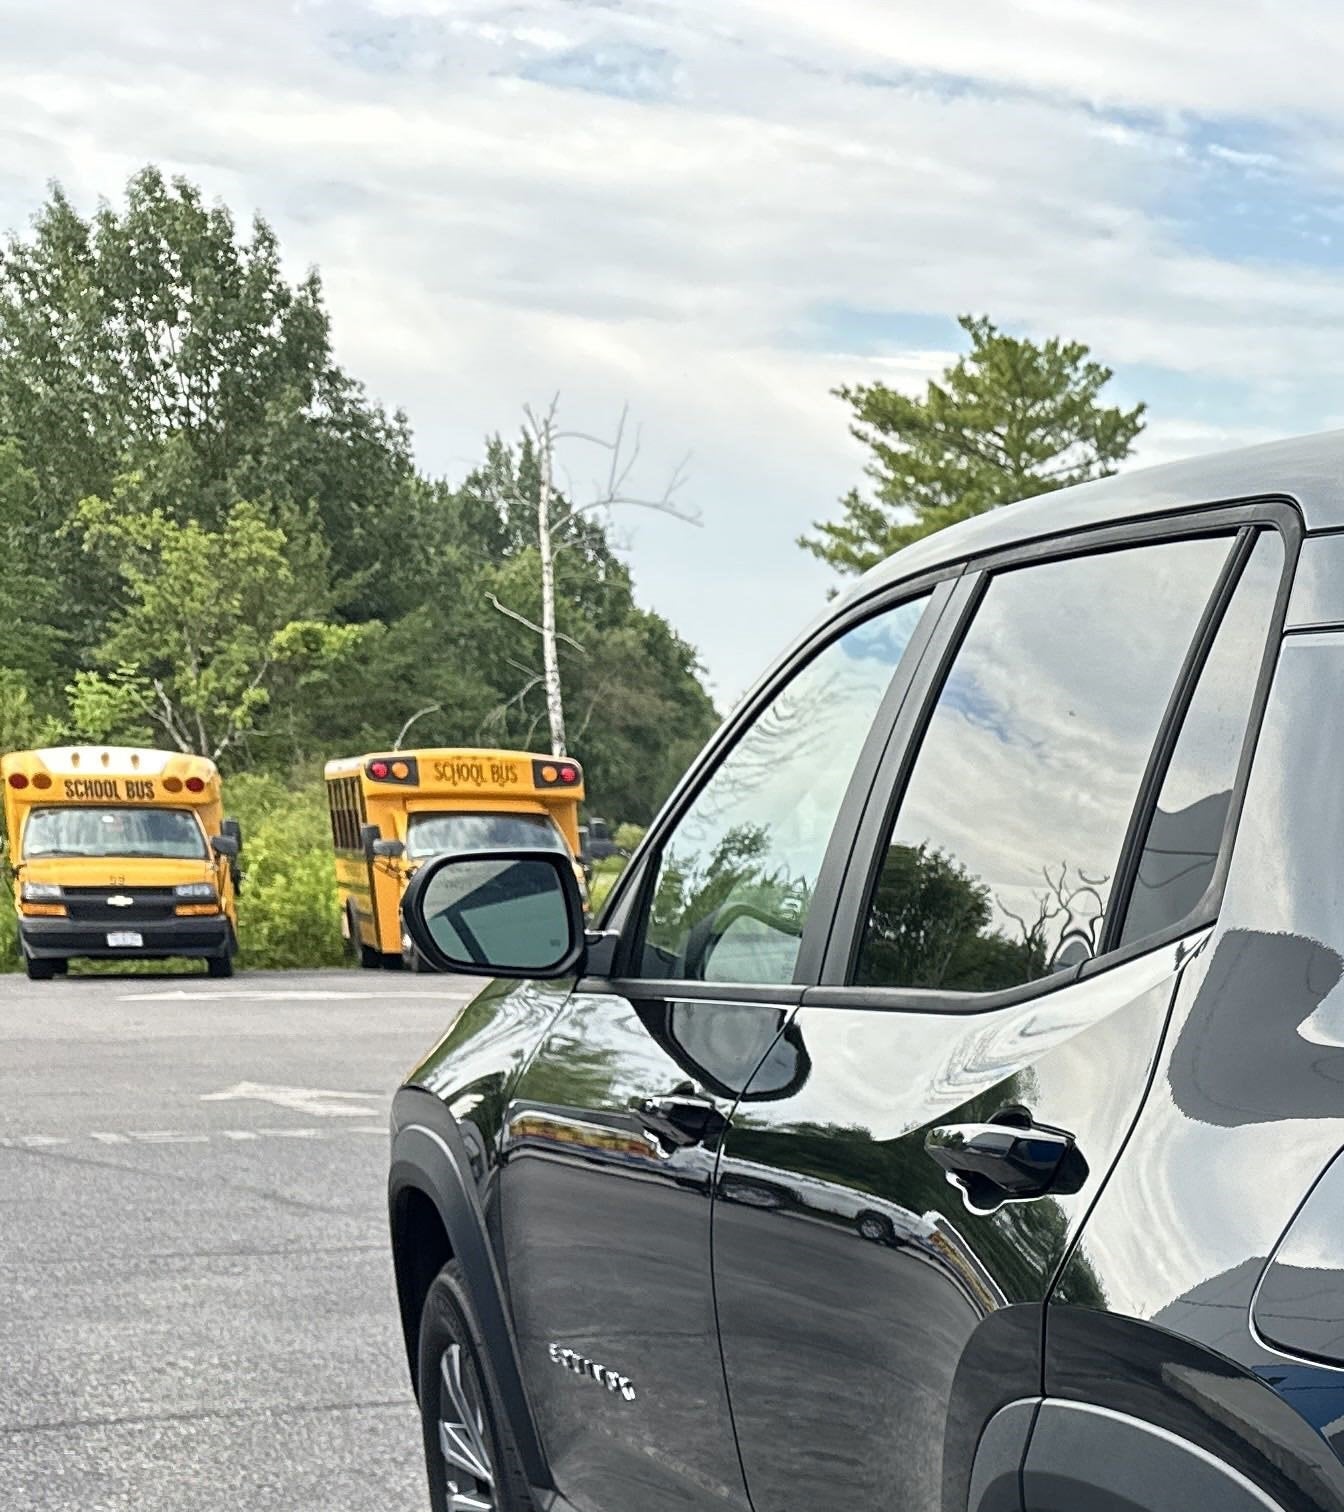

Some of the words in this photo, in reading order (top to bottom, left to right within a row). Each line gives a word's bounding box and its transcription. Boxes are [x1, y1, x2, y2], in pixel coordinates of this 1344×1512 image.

[434, 761, 487, 787] SCHOOL
[490, 763, 518, 787] BUS
[64, 779, 121, 800] SCHOOL
[125, 780, 155, 800] BUS
